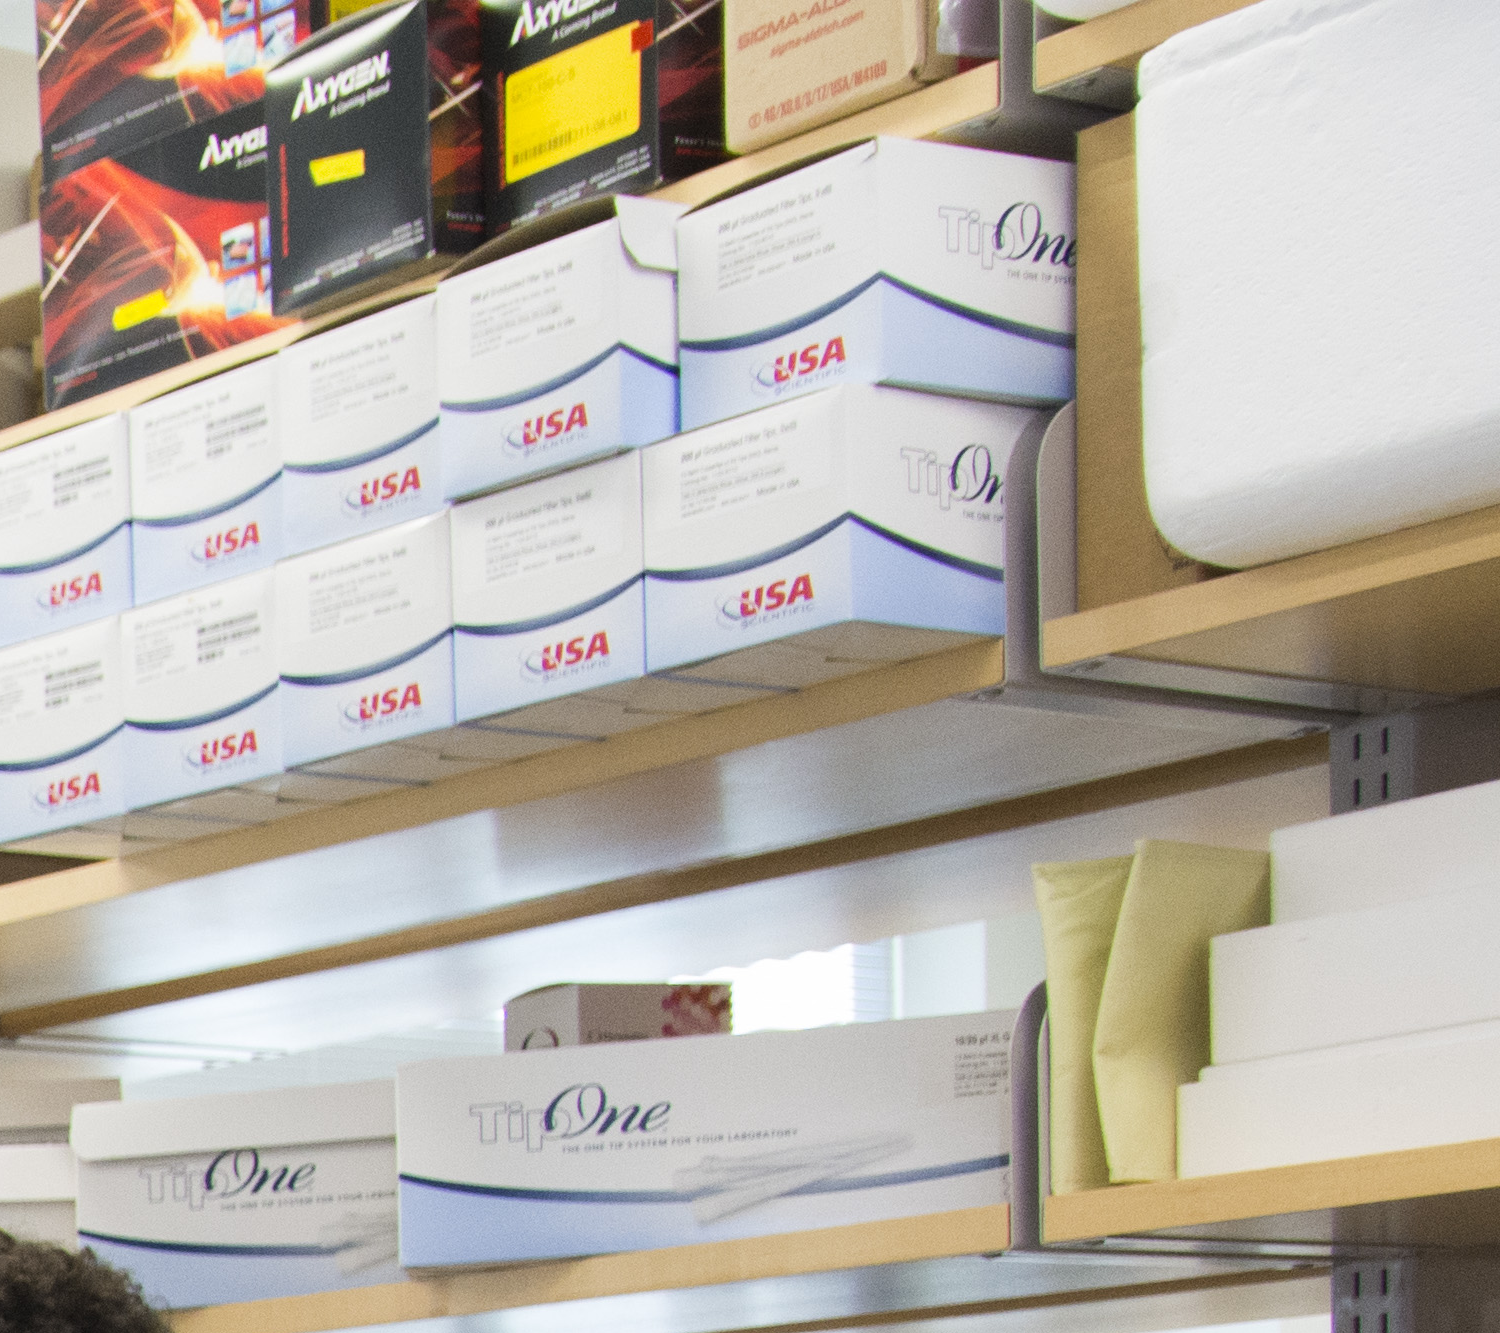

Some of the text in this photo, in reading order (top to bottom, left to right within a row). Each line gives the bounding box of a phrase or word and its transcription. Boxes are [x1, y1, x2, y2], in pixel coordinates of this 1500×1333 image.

[773, 336, 847, 383] USA
[522, 402, 588, 446] USA
[361, 466, 422, 506] USA
[204, 523, 260, 558] USA
[50, 572, 102, 606] USA
[740, 574, 814, 617] USA
[542, 630, 610, 671] USA
[359, 683, 422, 721] USA
[200, 730, 258, 765] USA
[47, 773, 100, 805] USA
[469, 1082, 672, 1153] TipOne
[562, 1127, 798, 1155] THE ONE TIP SYSTEM FOR YOUR LABORATORY
